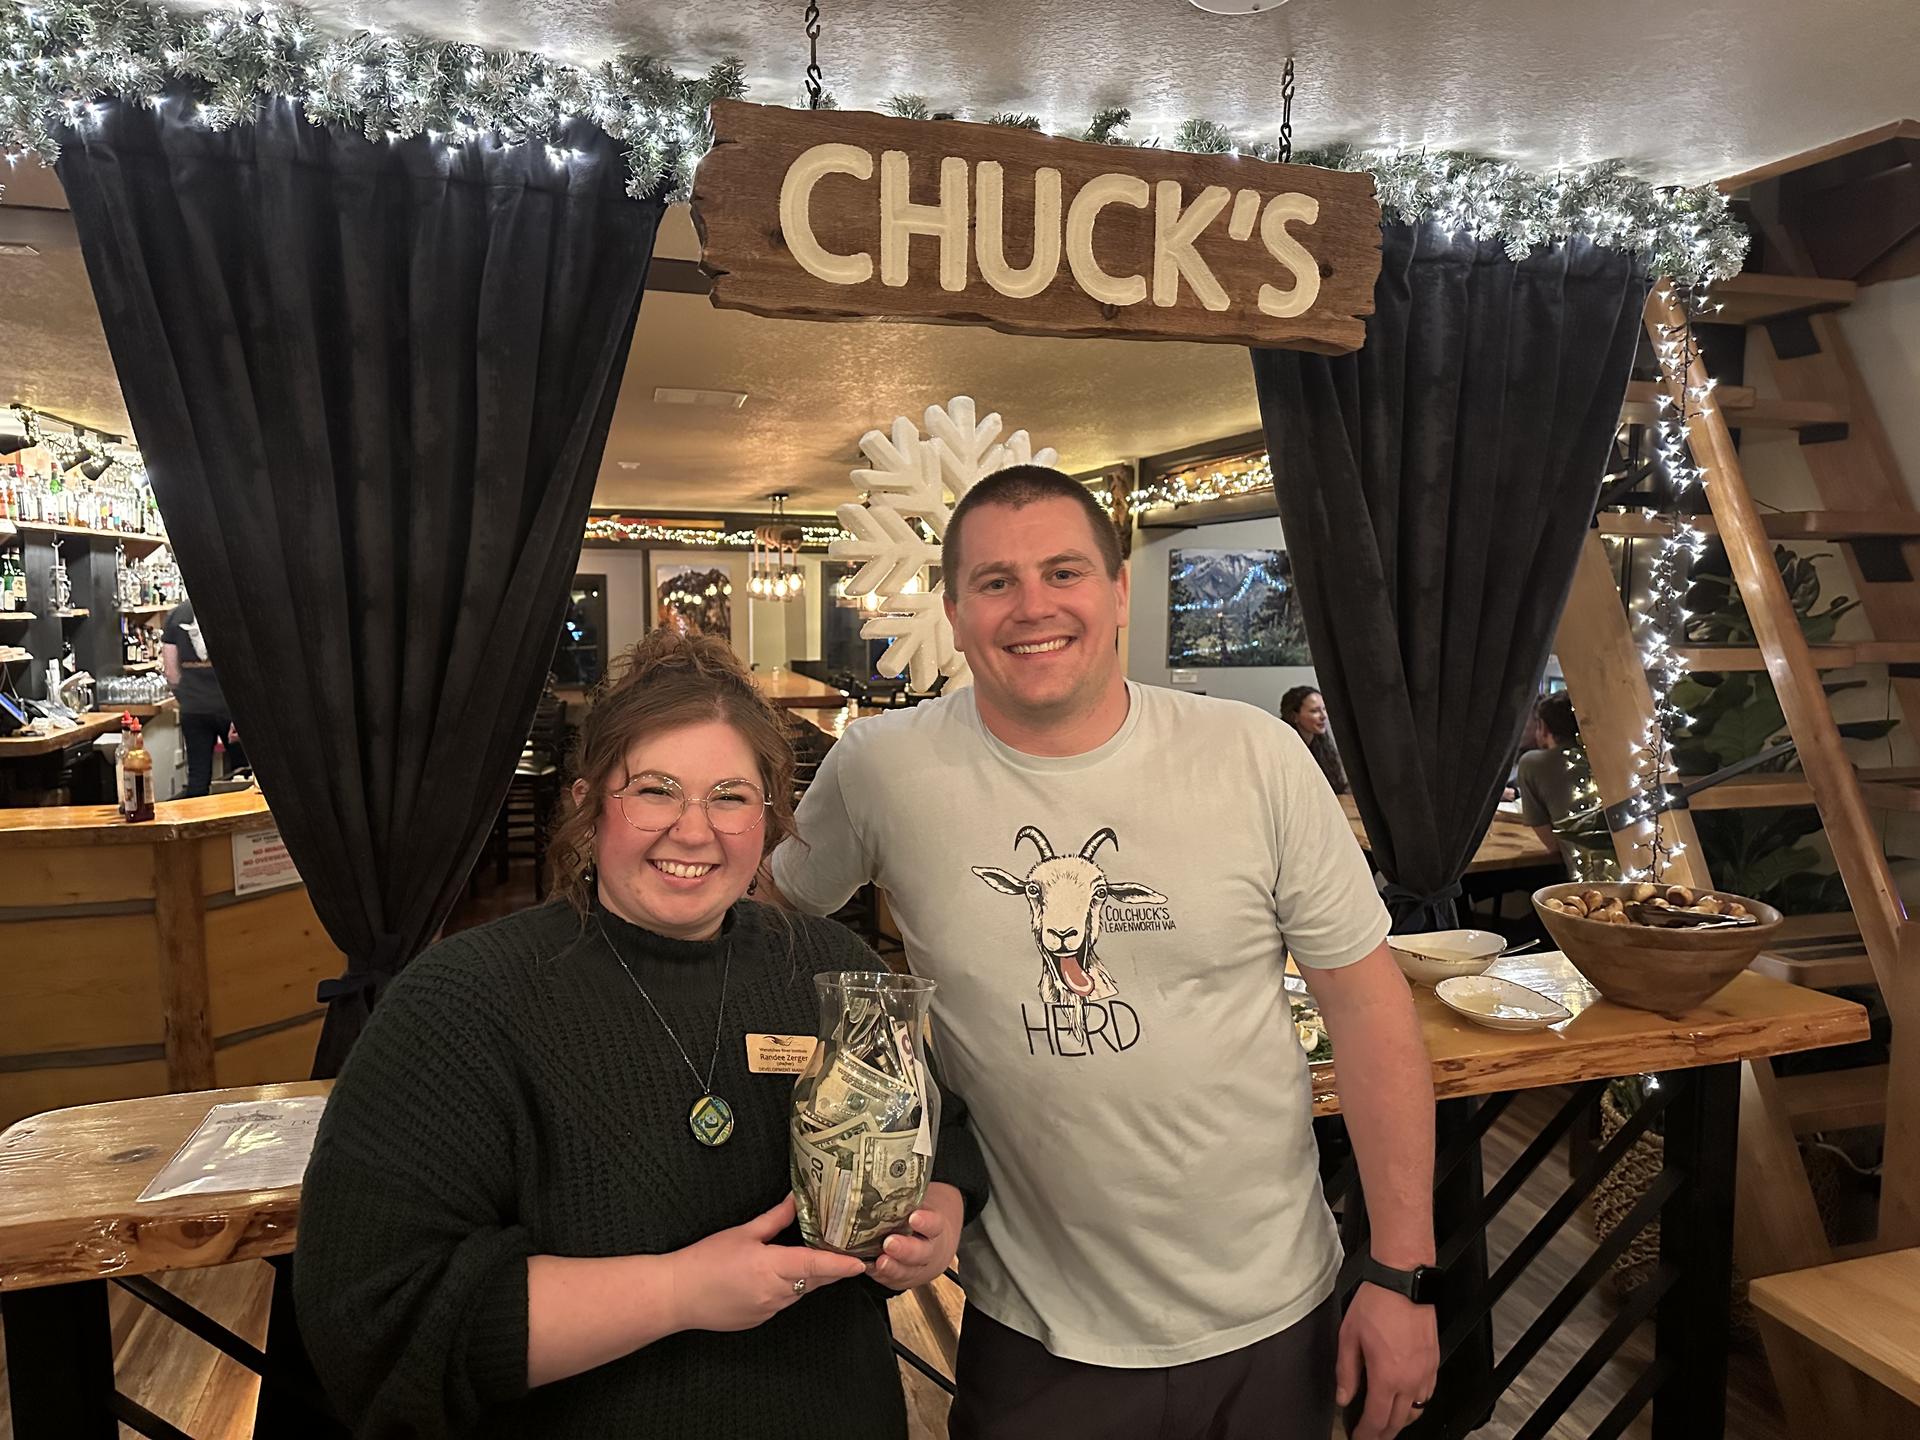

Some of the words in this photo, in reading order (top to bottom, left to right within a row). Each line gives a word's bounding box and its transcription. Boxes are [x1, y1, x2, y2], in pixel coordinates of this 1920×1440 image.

[779, 143, 1320, 318] CHUCK'S
[1105, 905, 1170, 921] COLCHUCK'S
[1104, 921, 1160, 933] LEAVENWORTH
[1161, 920, 1176, 931] WA
[1021, 1000, 1140, 1056] HERD
[760, 1053, 786, 1061] Randee
[786, 1054, 808, 1064] Zerger
[811, 1157, 823, 1184] 20
